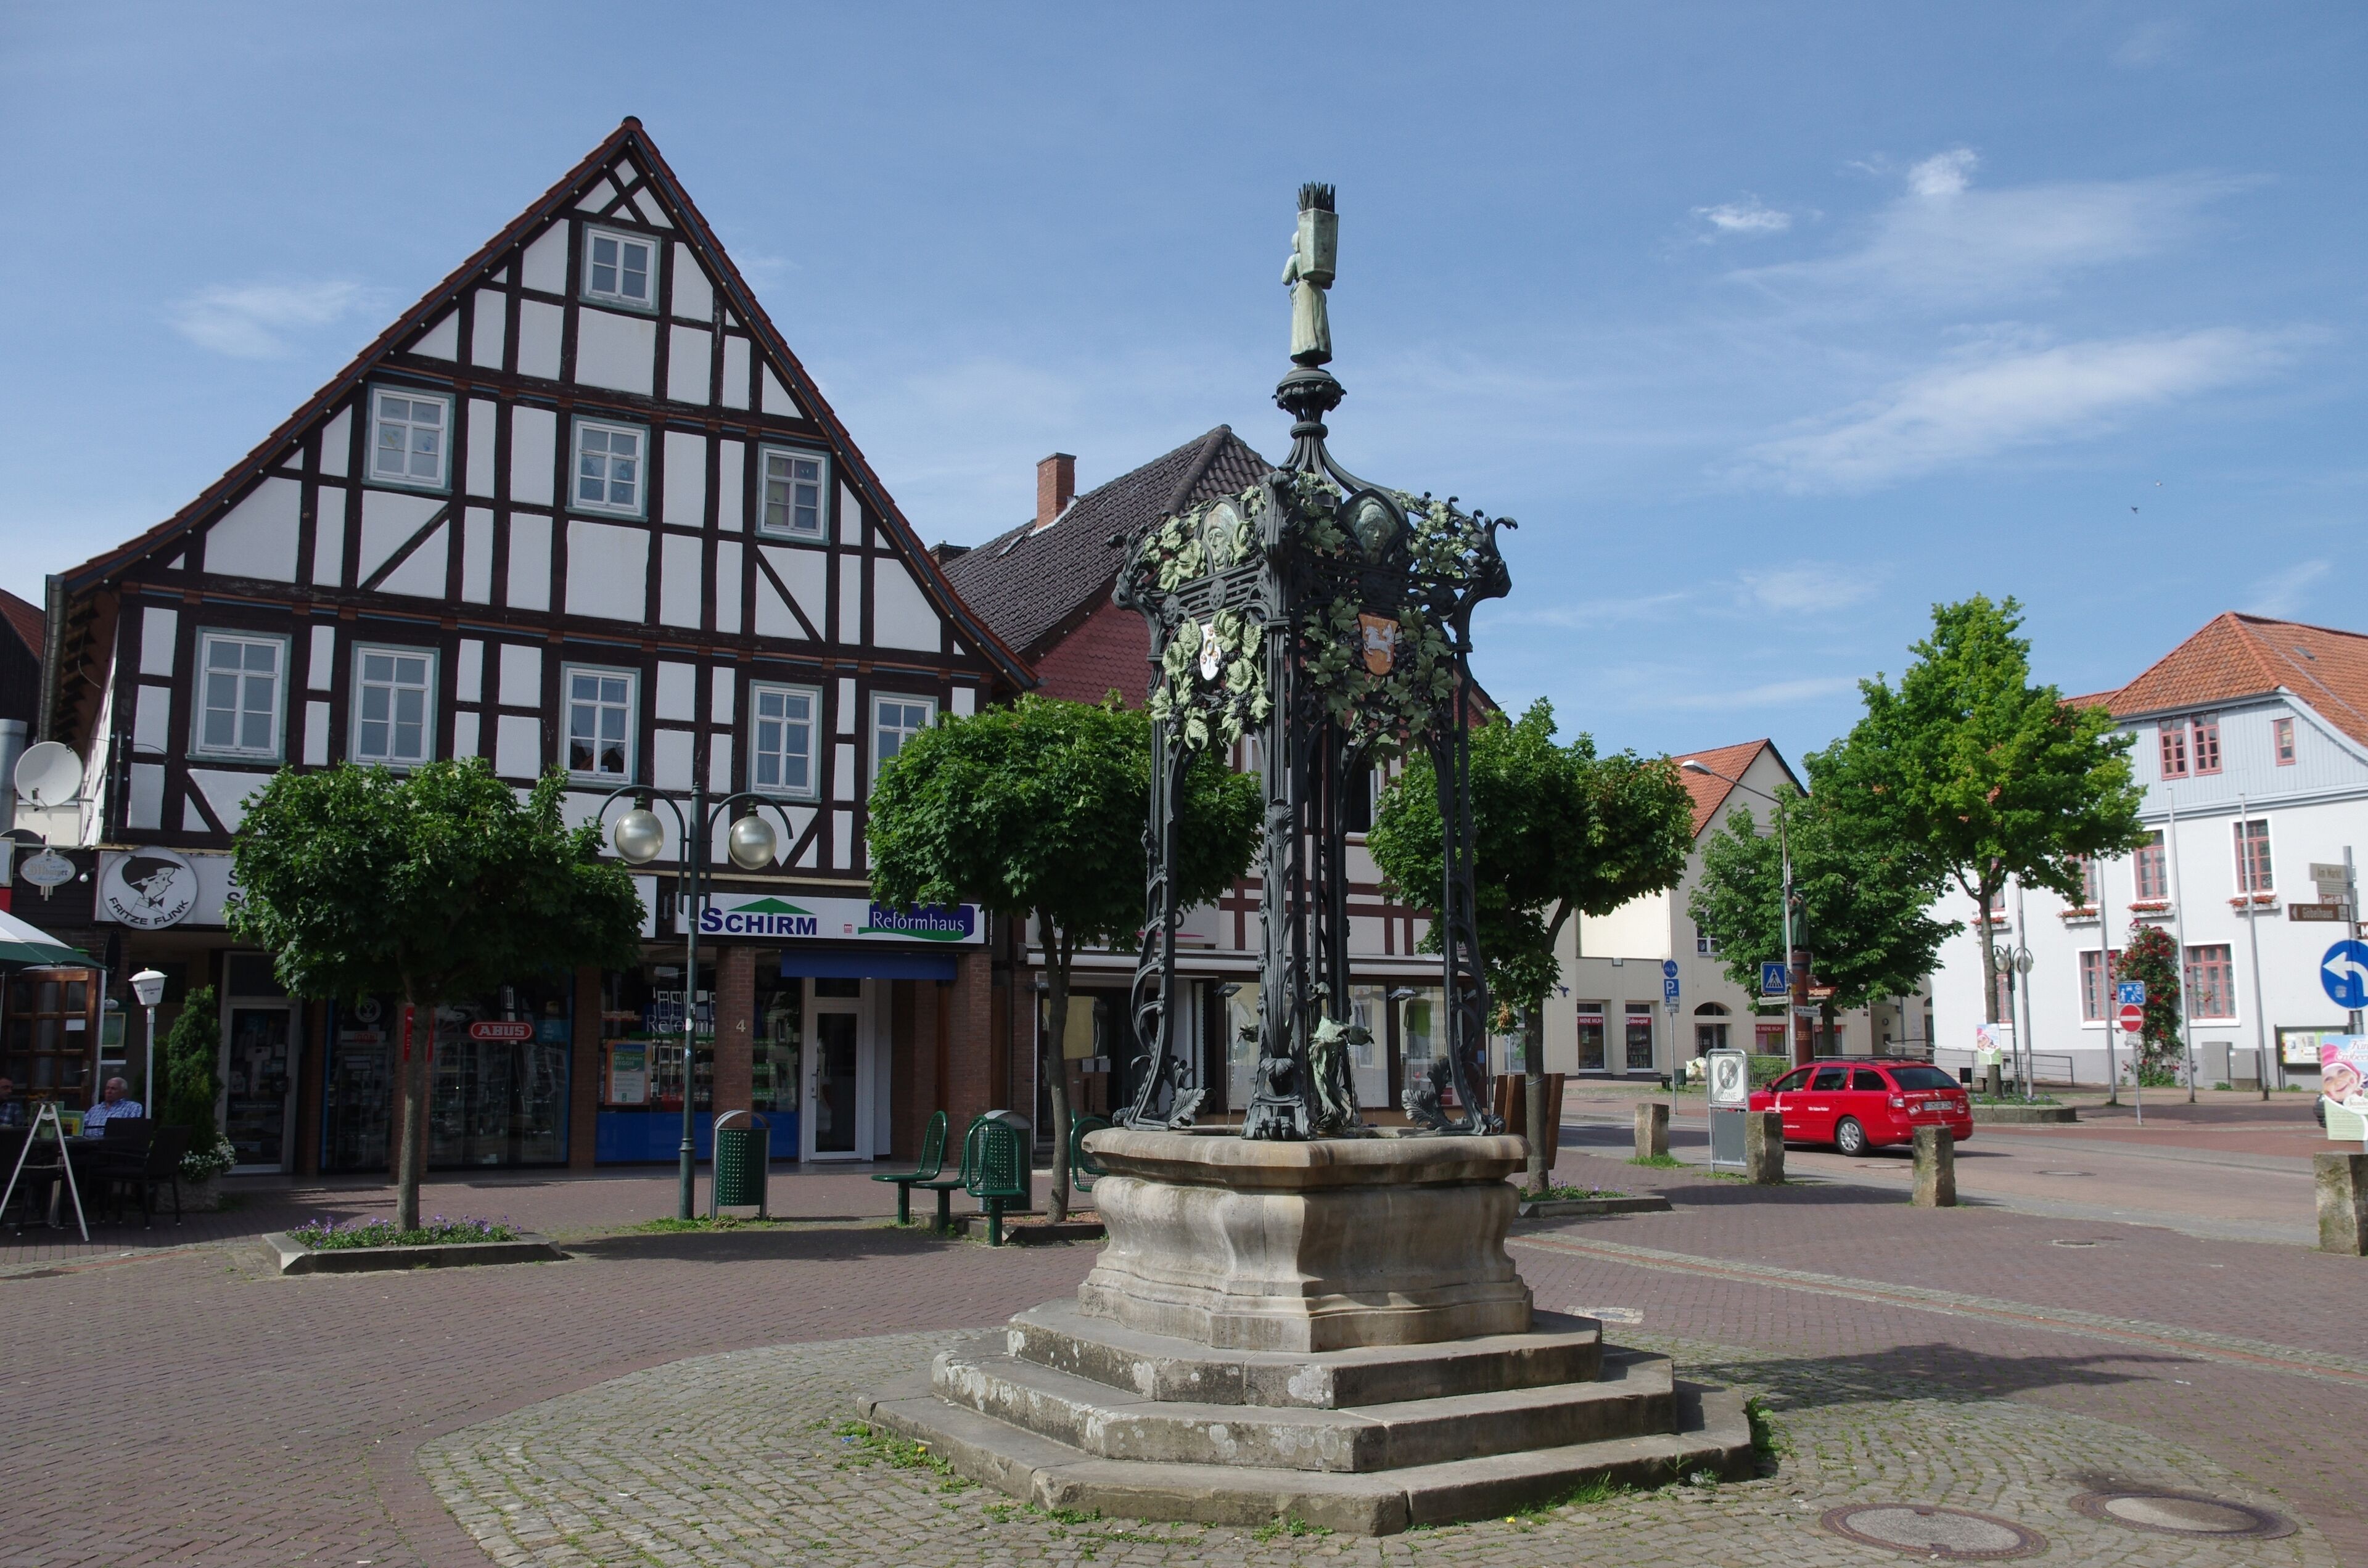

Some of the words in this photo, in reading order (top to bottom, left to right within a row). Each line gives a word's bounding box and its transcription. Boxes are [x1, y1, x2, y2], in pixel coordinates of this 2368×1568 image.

[109, 897, 148, 926] FRITZE
[154, 900, 189, 925] FLINK
[700, 908, 817, 935] SCHIRM
[873, 911, 964, 932] Reformhaus
[1666, 980, 1675, 995] P
[479, 1025, 524, 1036] ABUS
[736, 1019, 746, 1032] 4
[1720, 1092, 1737, 1101] ZONE
